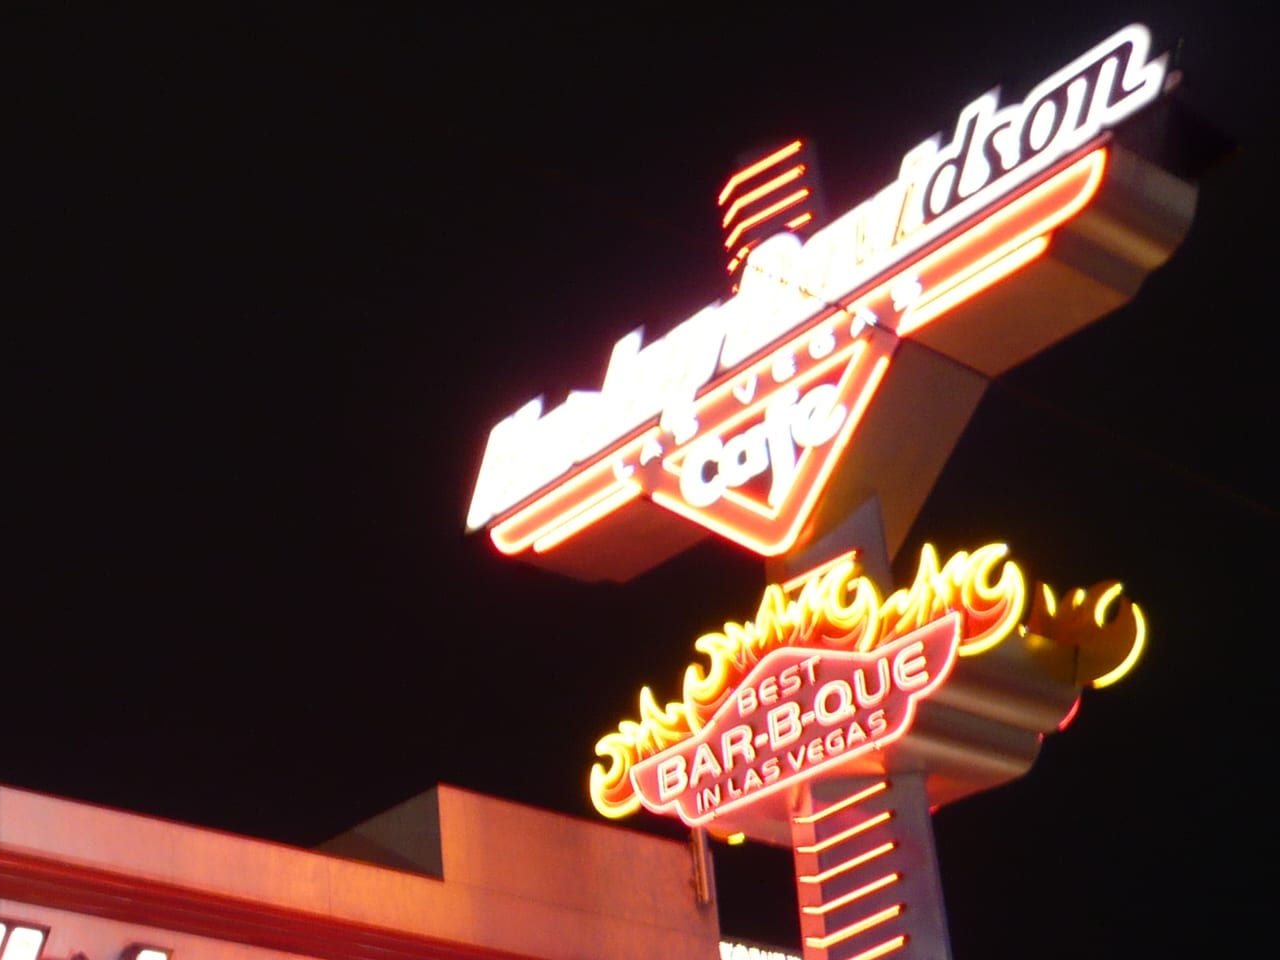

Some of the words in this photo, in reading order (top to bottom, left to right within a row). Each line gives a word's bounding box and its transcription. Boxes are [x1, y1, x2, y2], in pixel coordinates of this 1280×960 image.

[656, 640, 930, 802] BAR-B-QUE
[734, 654, 822, 718] BEST
[694, 783, 721, 816] IN
[726, 756, 781, 807] LAS
[785, 708, 889, 775] VEGAS
